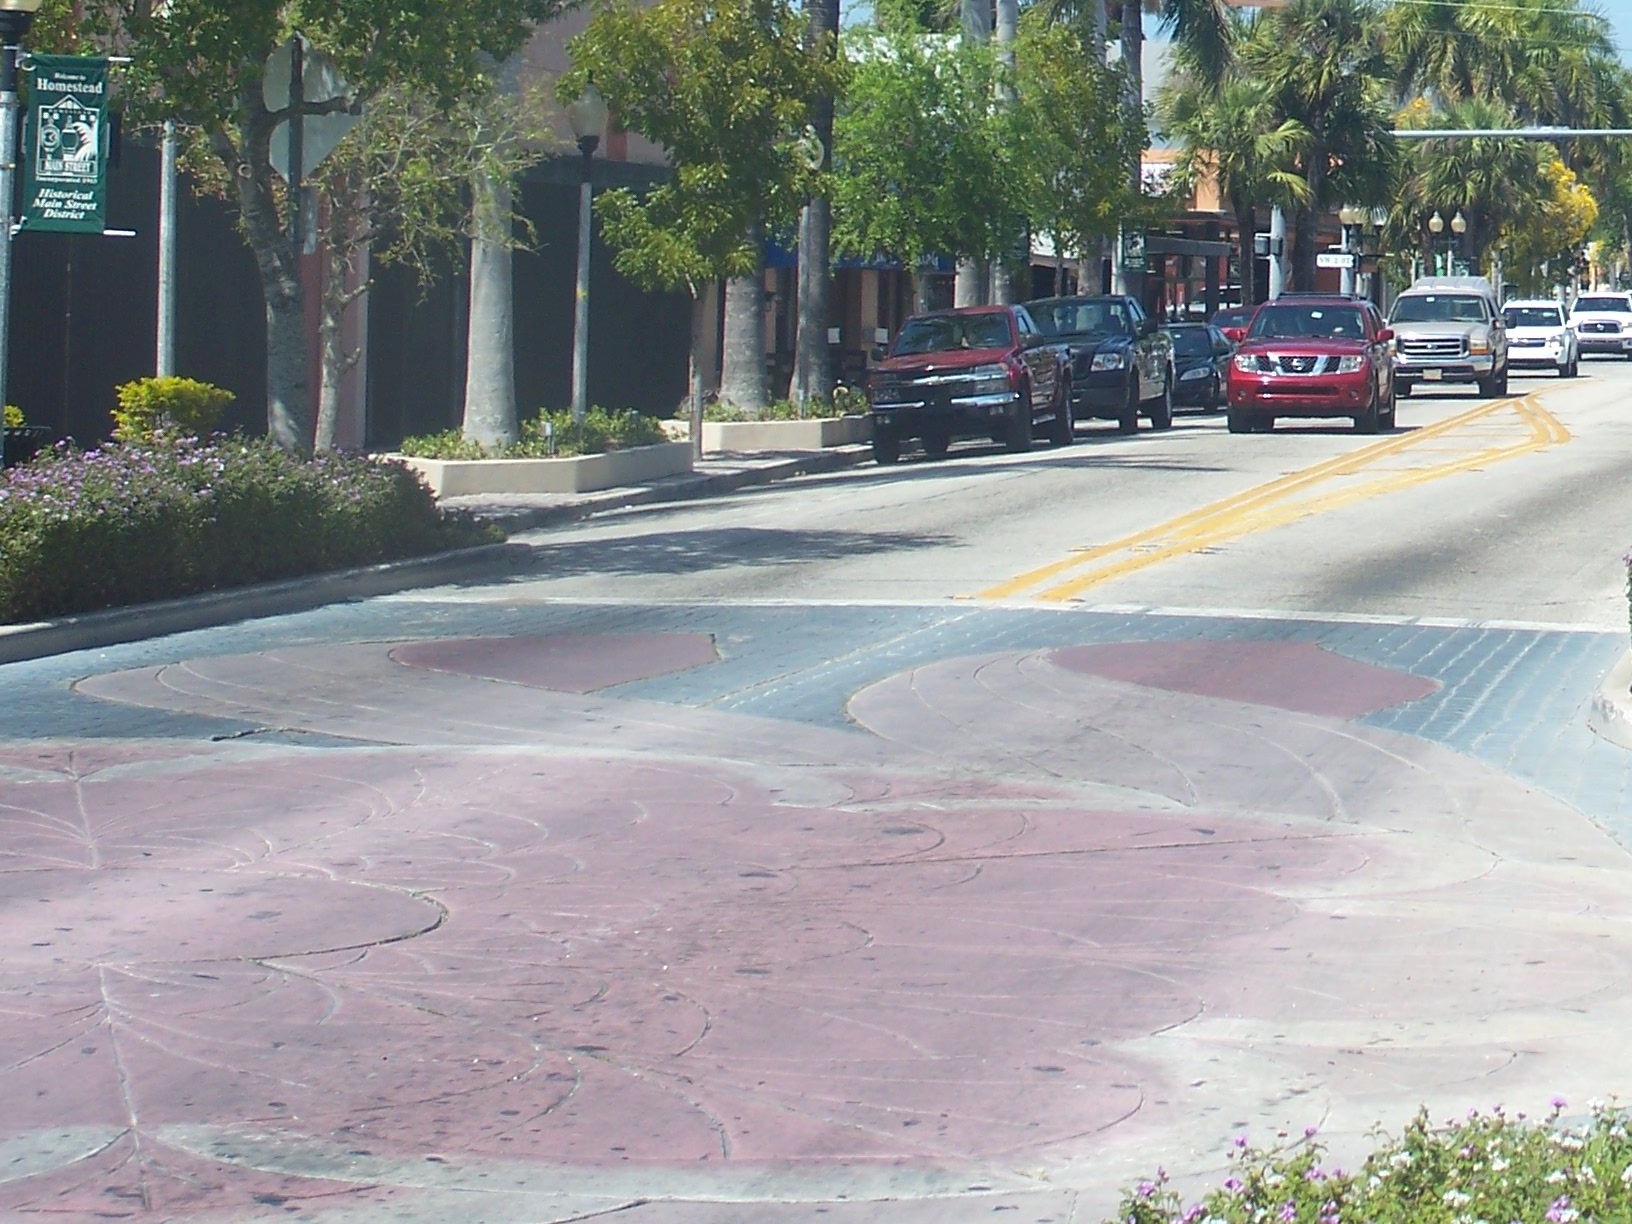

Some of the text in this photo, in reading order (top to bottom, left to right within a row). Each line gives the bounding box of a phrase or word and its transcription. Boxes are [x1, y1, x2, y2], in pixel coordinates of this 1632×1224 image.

[37, 78, 103, 94] Homestead
[64, 161, 91, 172] STREET
[38, 188, 94, 200] Historical
[32, 198, 98, 211] Main Street
[43, 209, 85, 220] District
